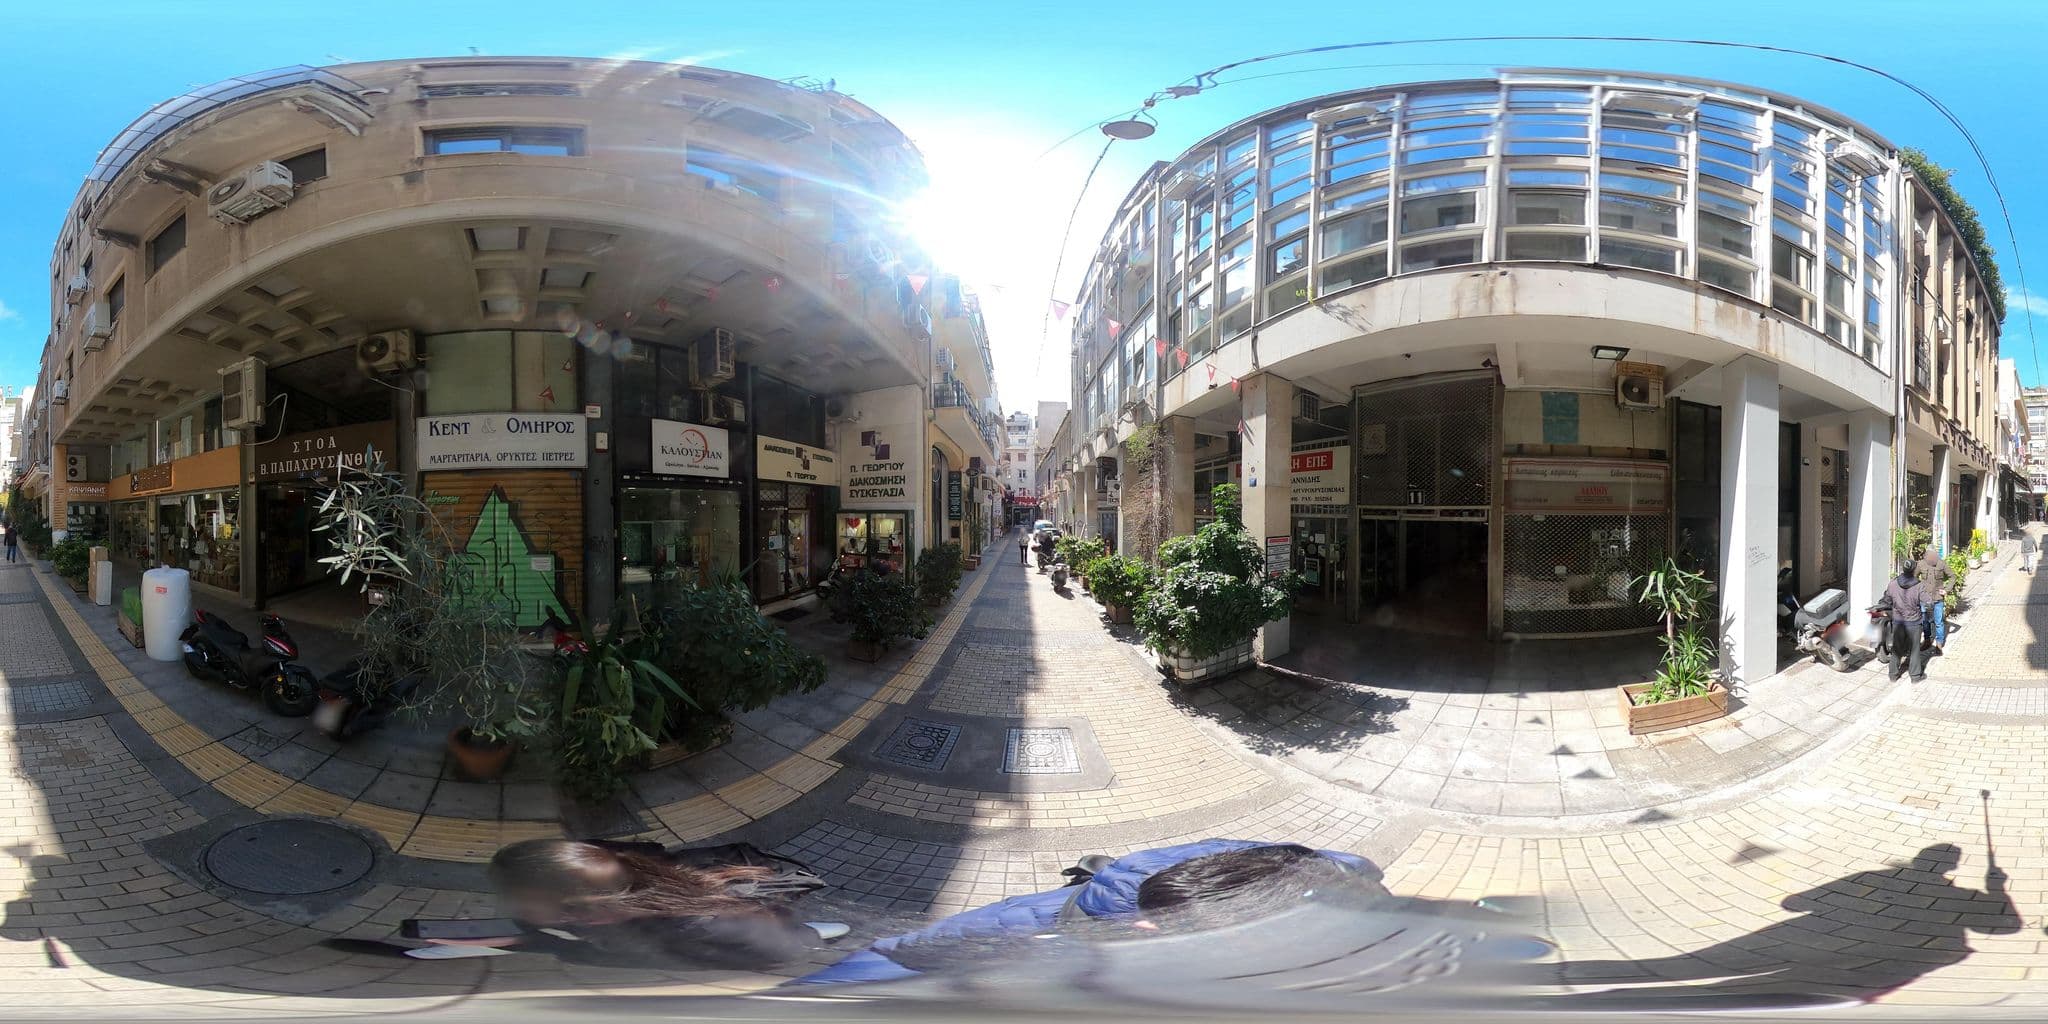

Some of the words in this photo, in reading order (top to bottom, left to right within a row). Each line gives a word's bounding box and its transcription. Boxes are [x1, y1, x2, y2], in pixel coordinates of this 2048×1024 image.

[429, 420, 470, 437] ΚΕΝΤ
[507, 417, 575, 434] ΟΜΗΡΟΣ
[292, 435, 337, 454] ΣΤΟΑ
[496, 452, 537, 462] ΟΡΥΚΤΕΣ
[542, 452, 575, 462] ΠΕΤΡΕΣ
[1306, 455, 1328, 468] ΕΠΕ
[850, 465, 858, 473] Π.
[862, 462, 905, 472] ΓΕΩΡΓΙΟΥ
[849, 475, 906, 487] ΔΙΑΚΟΣΜΗΣΗ
[849, 487, 905, 498] ΣΥΣΚΕΥΑΣΙΑ
[1409, 491, 1423, 504] 11
